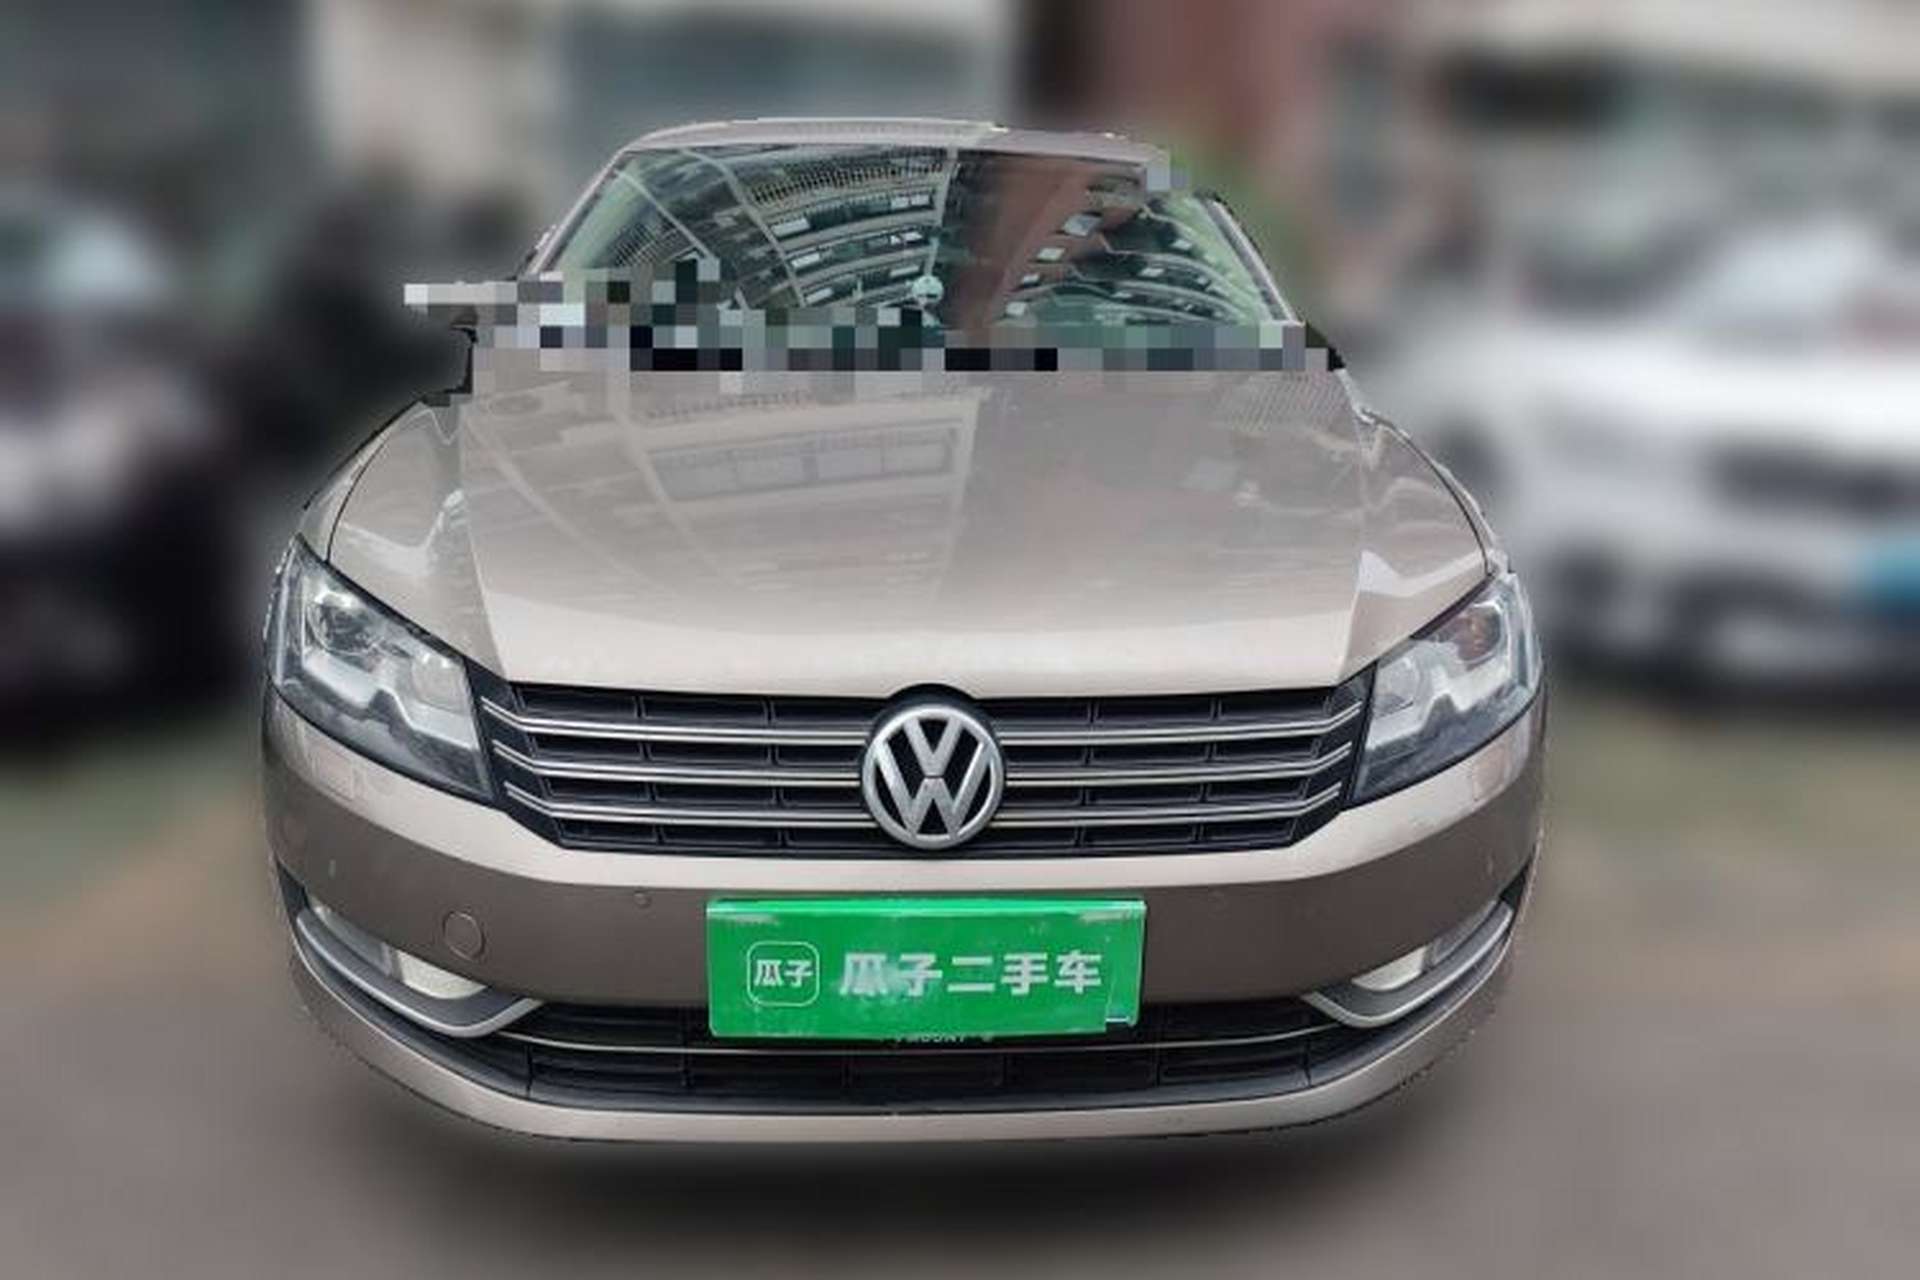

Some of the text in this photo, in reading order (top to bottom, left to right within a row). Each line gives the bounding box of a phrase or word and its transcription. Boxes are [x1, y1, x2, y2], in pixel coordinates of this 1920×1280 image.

[866, 706, 1000, 845] VW
[753, 958, 814, 987] 瓜子
[839, 951, 1103, 996] 瓜子二手车
